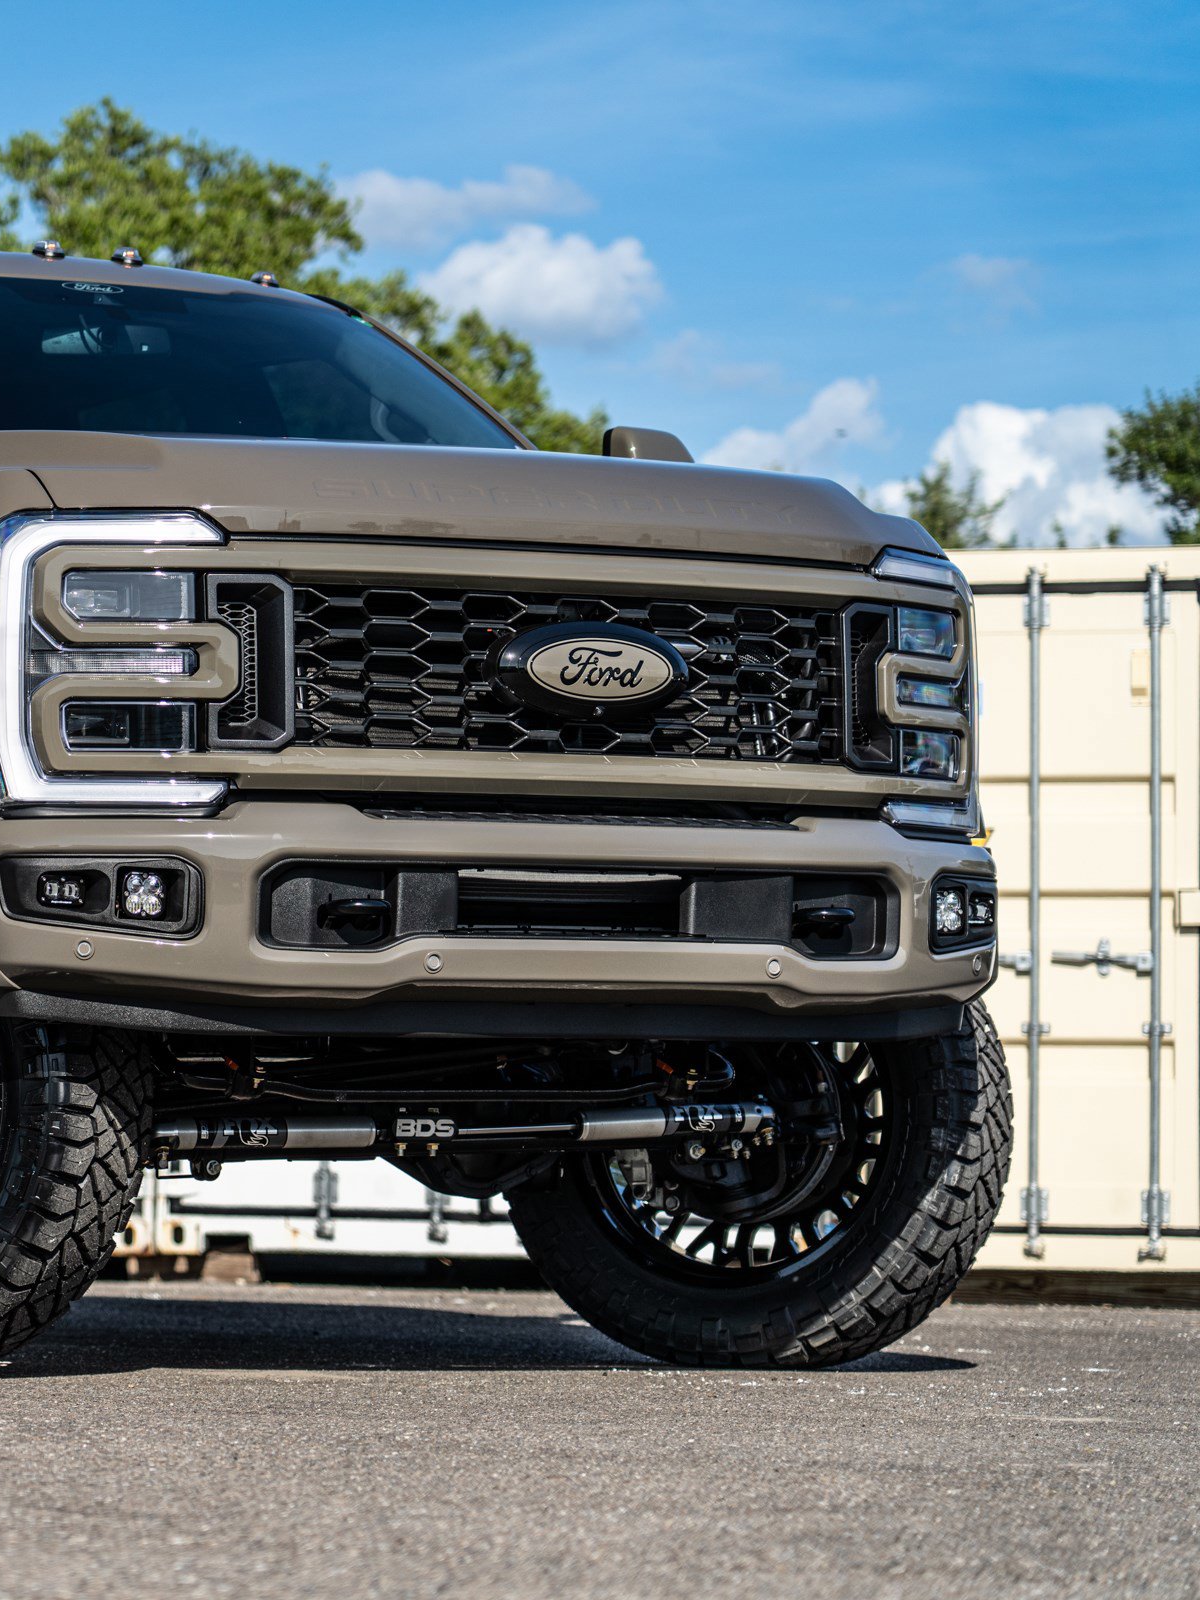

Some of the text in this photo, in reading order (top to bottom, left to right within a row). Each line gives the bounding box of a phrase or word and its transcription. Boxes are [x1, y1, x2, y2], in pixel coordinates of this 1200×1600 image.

[73, 283, 114, 293] Ford
[560, 647, 644, 688] Ford
[223, 1117, 278, 1147] FOX
[396, 1118, 455, 1137] BDS
[671, 1104, 723, 1132] FOX
